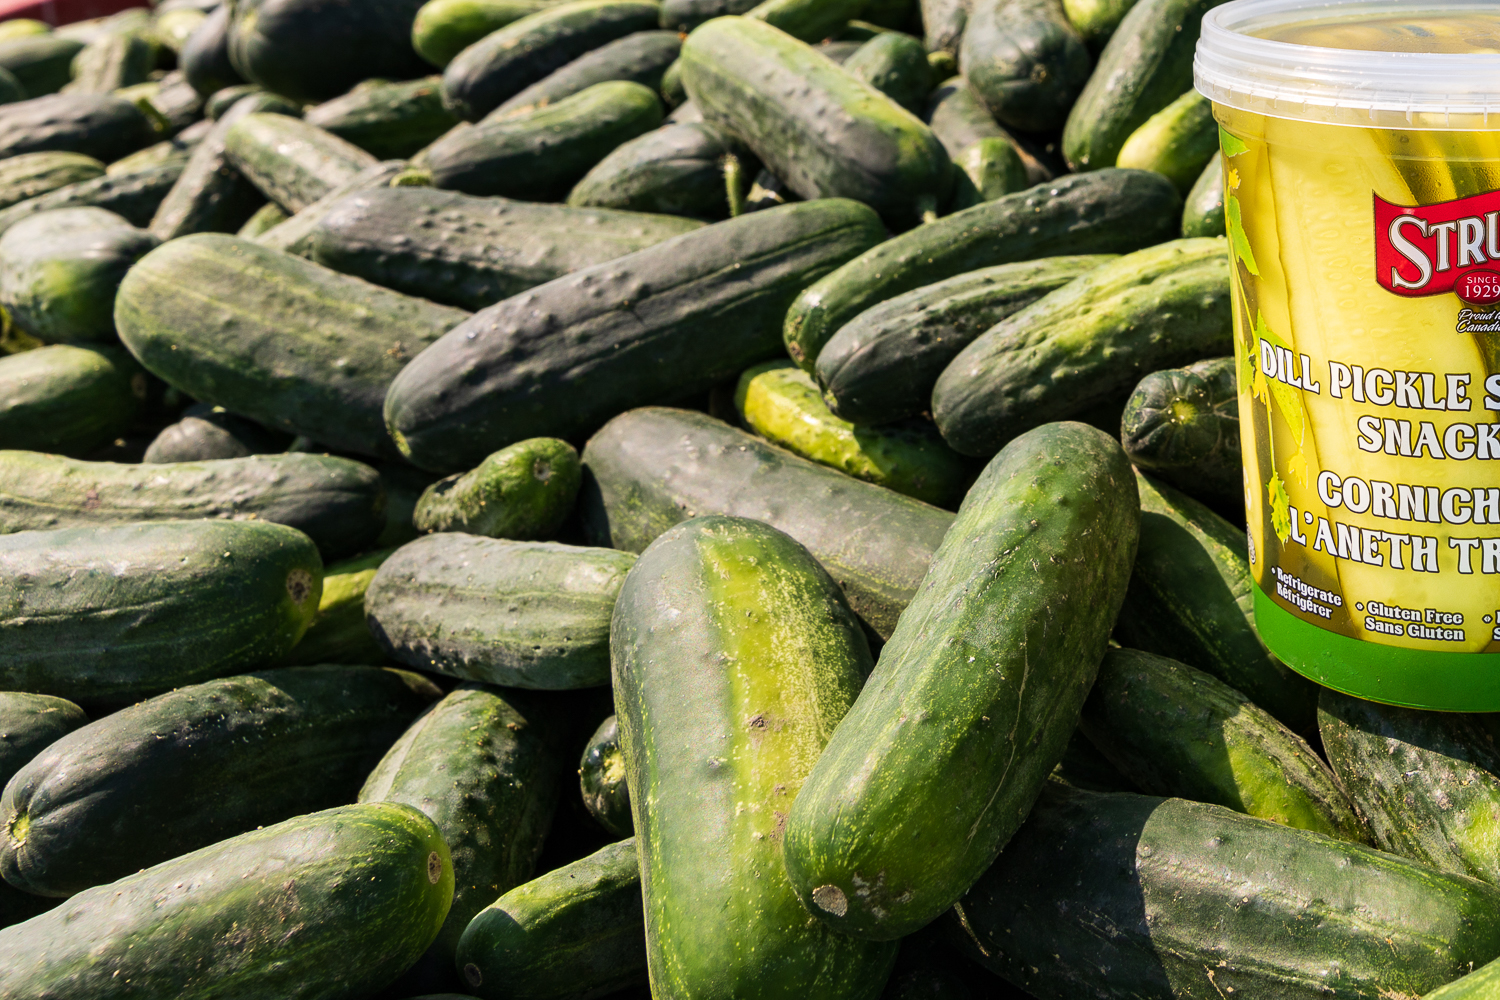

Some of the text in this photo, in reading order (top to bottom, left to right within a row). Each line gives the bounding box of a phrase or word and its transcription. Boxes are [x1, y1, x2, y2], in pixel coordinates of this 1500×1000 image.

[1464, 285, 1500, 298] 1929
[1466, 276, 1498, 285] SINCE
[1458, 308, 1494, 322] Proud
[1260, 337, 1320, 394] DILL
[1329, 361, 1471, 411] PICKLE
[1289, 506, 1440, 573] L'ANETH
[1276, 566, 1342, 607] Refrigerate
[1276, 581, 1332, 618] Réfrigérer
[1366, 601, 1464, 625] Gluten Free
[1365, 617, 1465, 641] Sans Gluten
